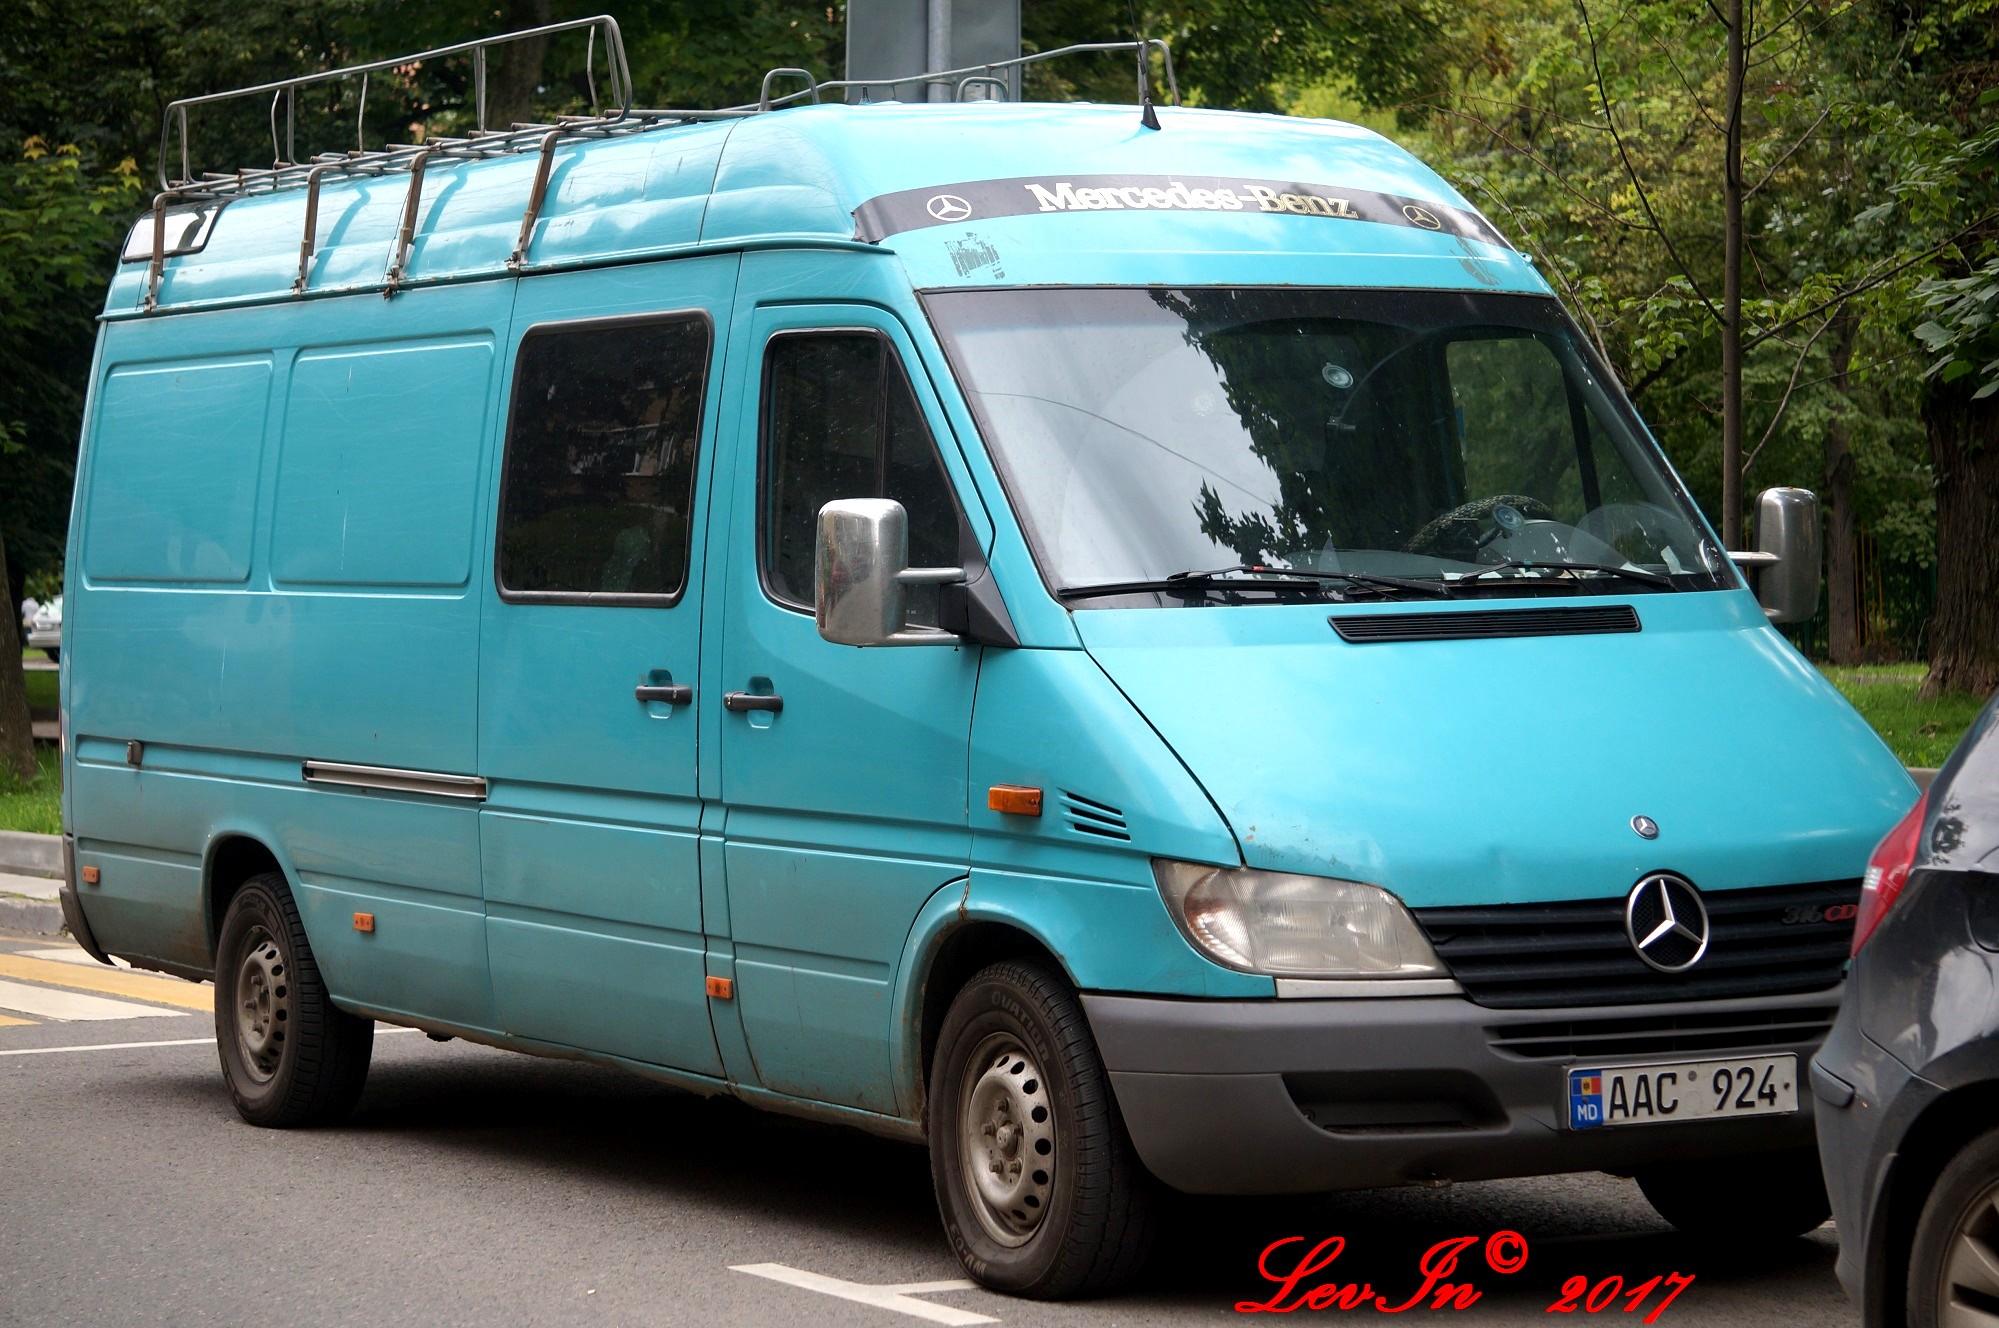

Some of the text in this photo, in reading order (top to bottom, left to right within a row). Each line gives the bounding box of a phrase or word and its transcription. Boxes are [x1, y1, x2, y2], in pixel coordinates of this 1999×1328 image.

[1025, 181, 1358, 219] Mercedes-Benz
[1609, 1064, 1777, 1119] AAC 924
[1577, 1104, 1598, 1121] MD
